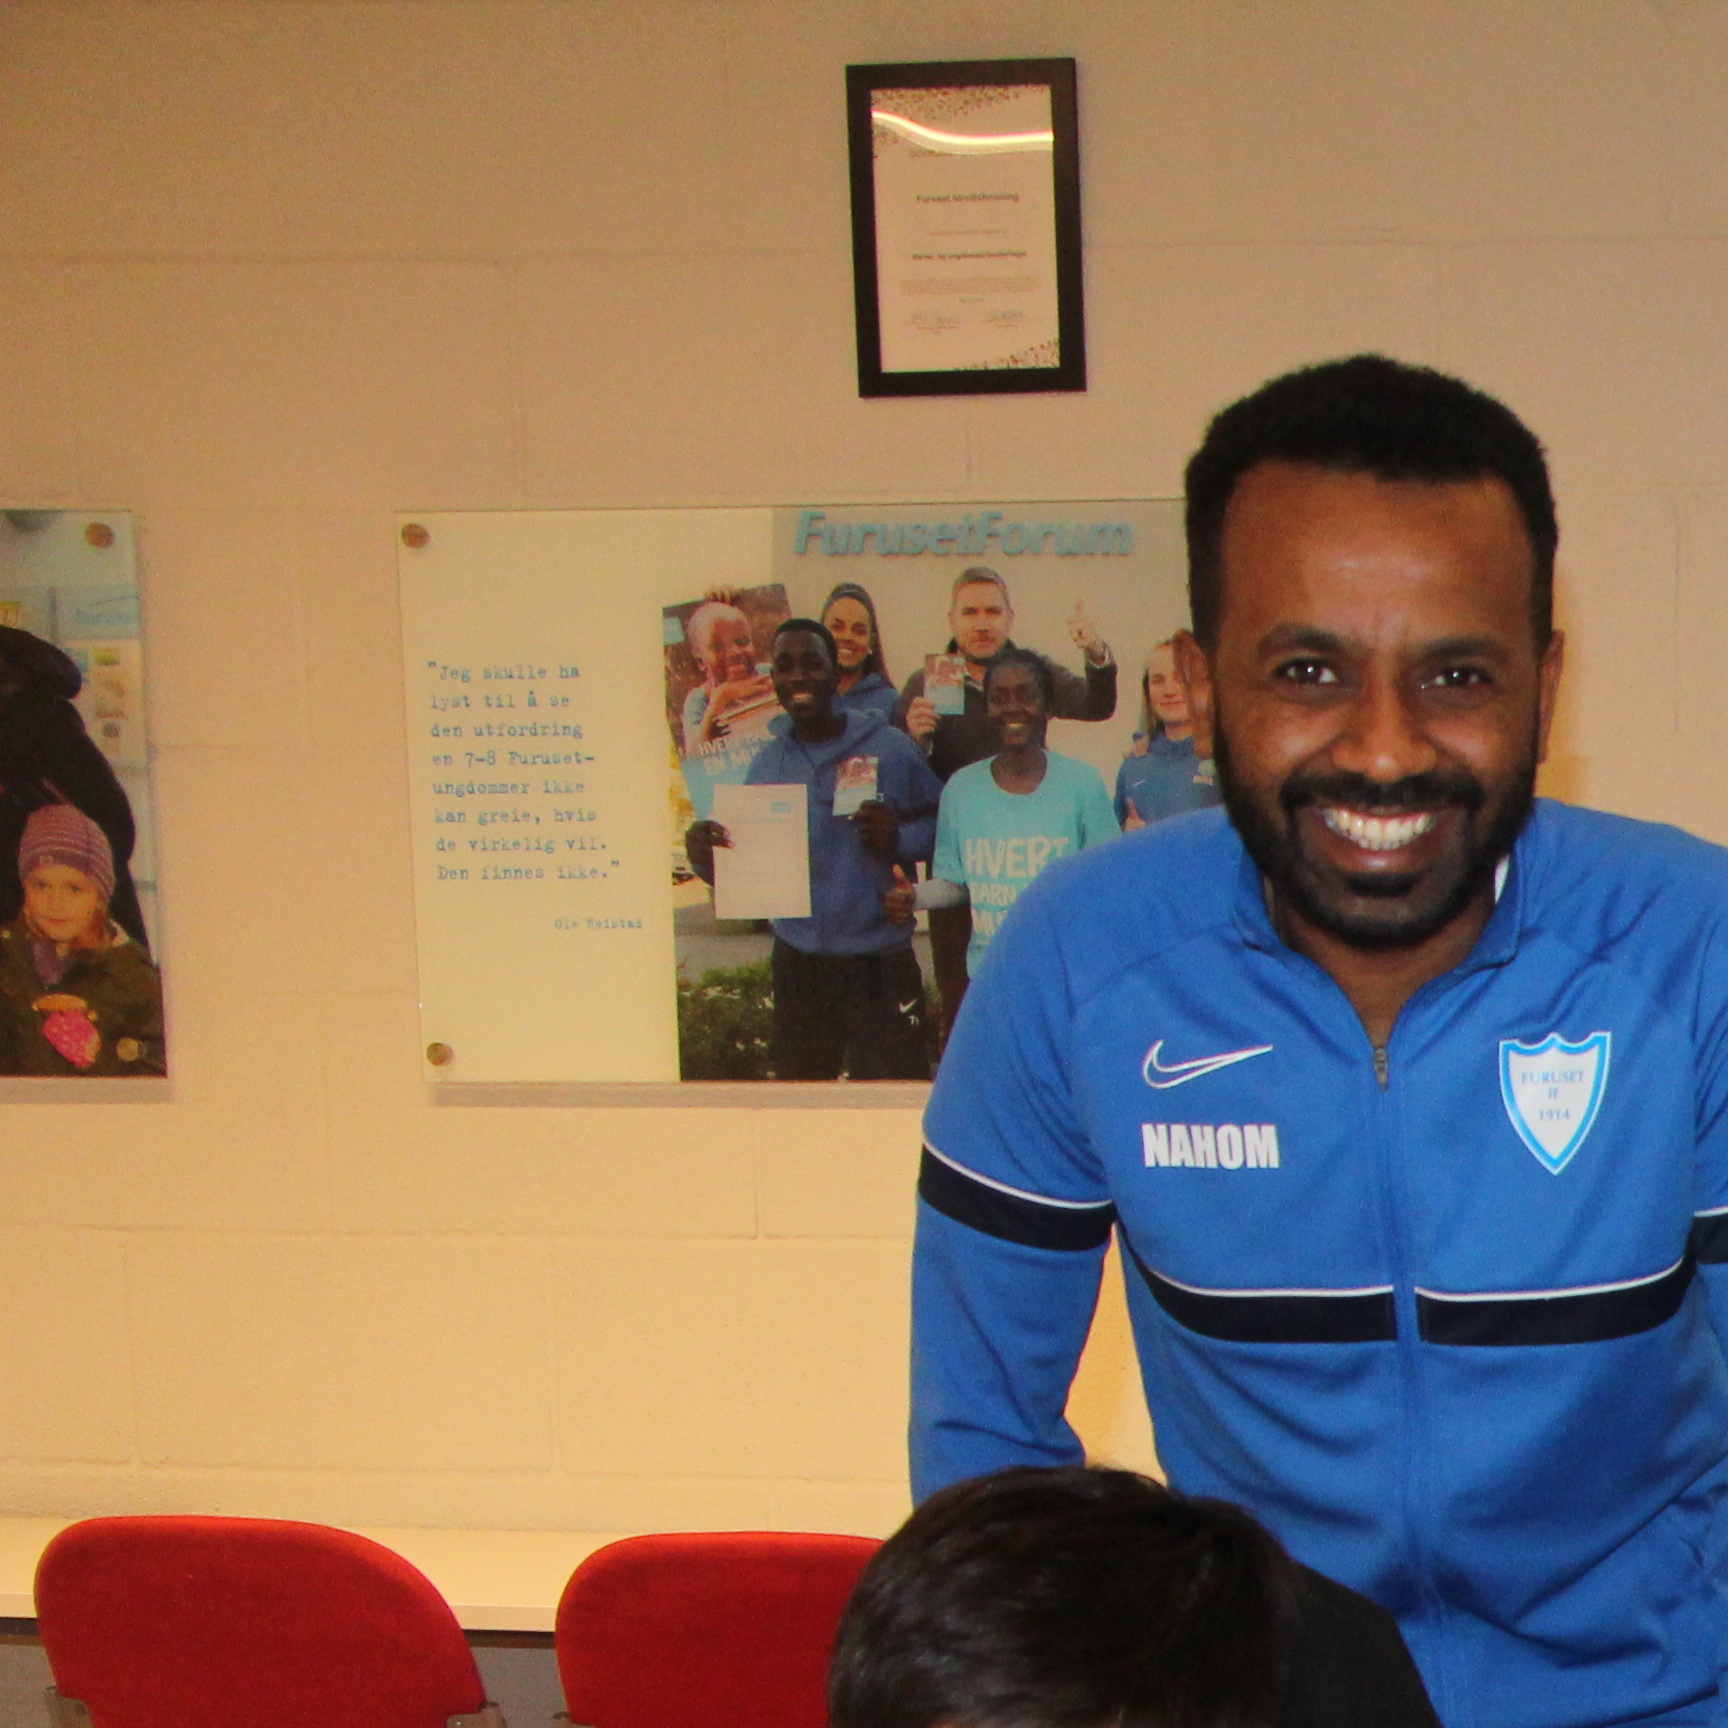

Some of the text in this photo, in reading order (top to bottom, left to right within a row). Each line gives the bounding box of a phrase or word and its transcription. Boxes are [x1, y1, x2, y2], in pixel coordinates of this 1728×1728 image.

[795, 509, 1134, 558] FurusetForum
[483, 665, 546, 680] skulle
[559, 665, 580, 679] ha
[431, 689, 570, 711] lyst til å se
[430, 722, 583, 739] den utfordring
[432, 753, 452, 765] en
[507, 750, 595, 765] Furuset-
[432, 780, 584, 798] ungdommer ikke
[434, 808, 596, 826] kan greie, hvis
[436, 837, 607, 854] de virkelig vil.
[437, 865, 469, 880] Den
[482, 866, 544, 880] finnes
[1520, 1070, 1585, 1084] FURUSET
[1539, 1108, 1570, 1121] 1914
[1141, 1123, 1280, 1170] NAHOM
